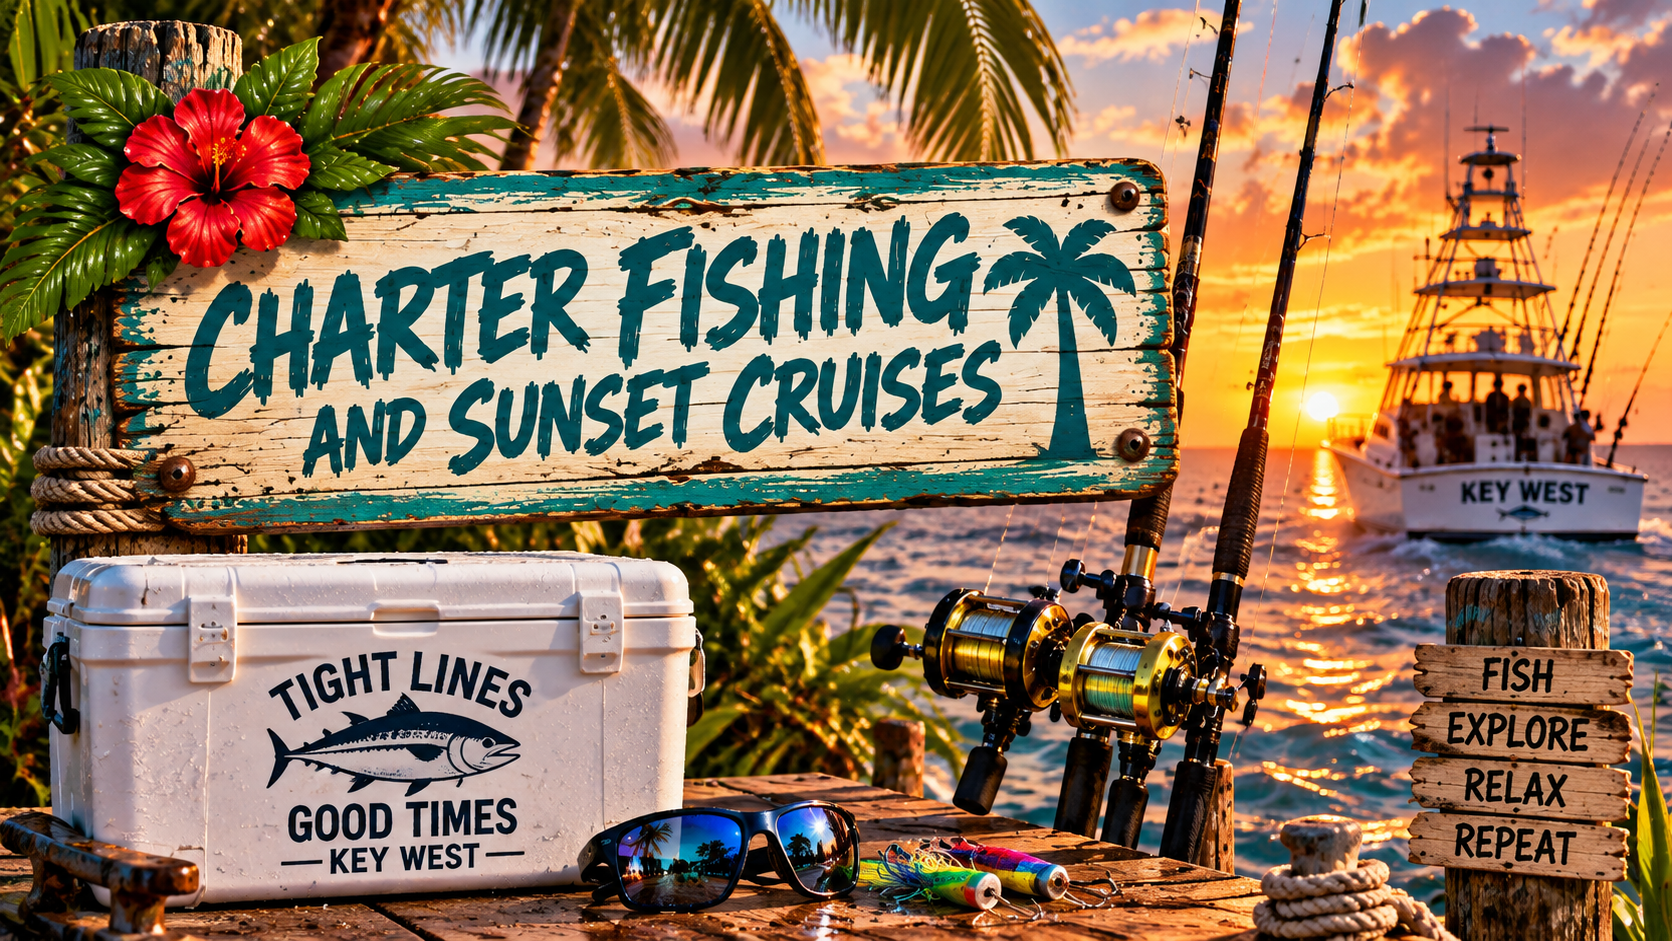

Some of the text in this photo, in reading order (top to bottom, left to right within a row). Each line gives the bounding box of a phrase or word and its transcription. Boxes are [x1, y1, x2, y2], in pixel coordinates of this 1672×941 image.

[185, 212, 982, 419] CHARTER FISHING
[302, 339, 1002, 477] AND SUNSET CRUISES
[1461, 480, 1510, 504] KEY
[1518, 480, 1589, 505] WEST
[268, 651, 532, 721] TIGHT LINES
[1482, 657, 1554, 693] FISH
[1447, 712, 1590, 752] EXPLORE
[1464, 768, 1568, 808] RELAX
[288, 798, 518, 843] GOOD TIMES
[330, 843, 480, 874] KEY WEST
[1455, 823, 1577, 866] REPEAT
